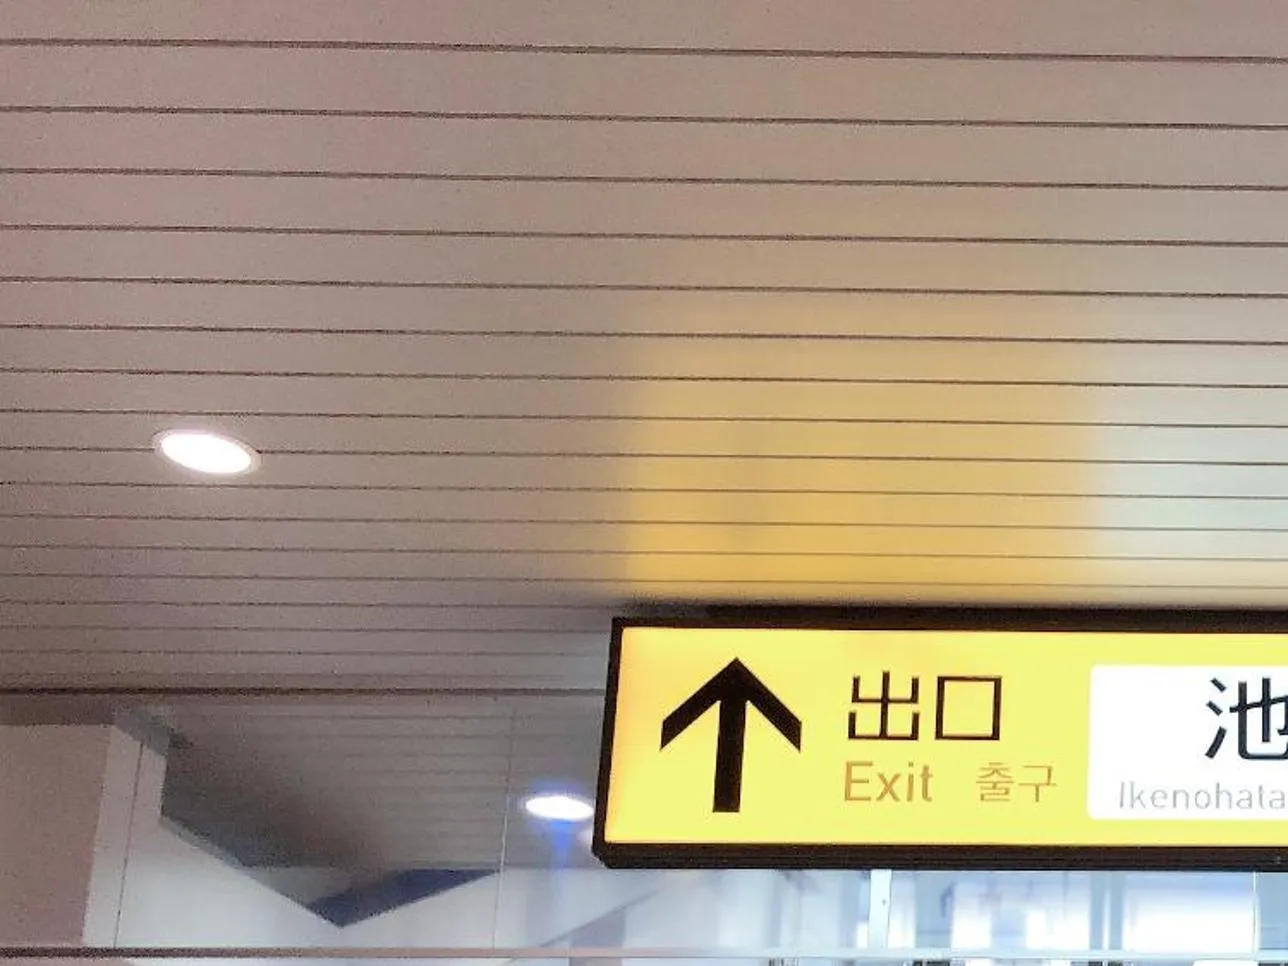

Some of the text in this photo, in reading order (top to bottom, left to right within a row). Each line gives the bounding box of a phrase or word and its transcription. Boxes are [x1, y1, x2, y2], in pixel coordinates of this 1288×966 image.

[847, 669, 1002, 741] 出口
[844, 760, 934, 803] Exit
[975, 761, 1057, 803] 출구
[1118, 780, 1286, 810] Ikenohata
